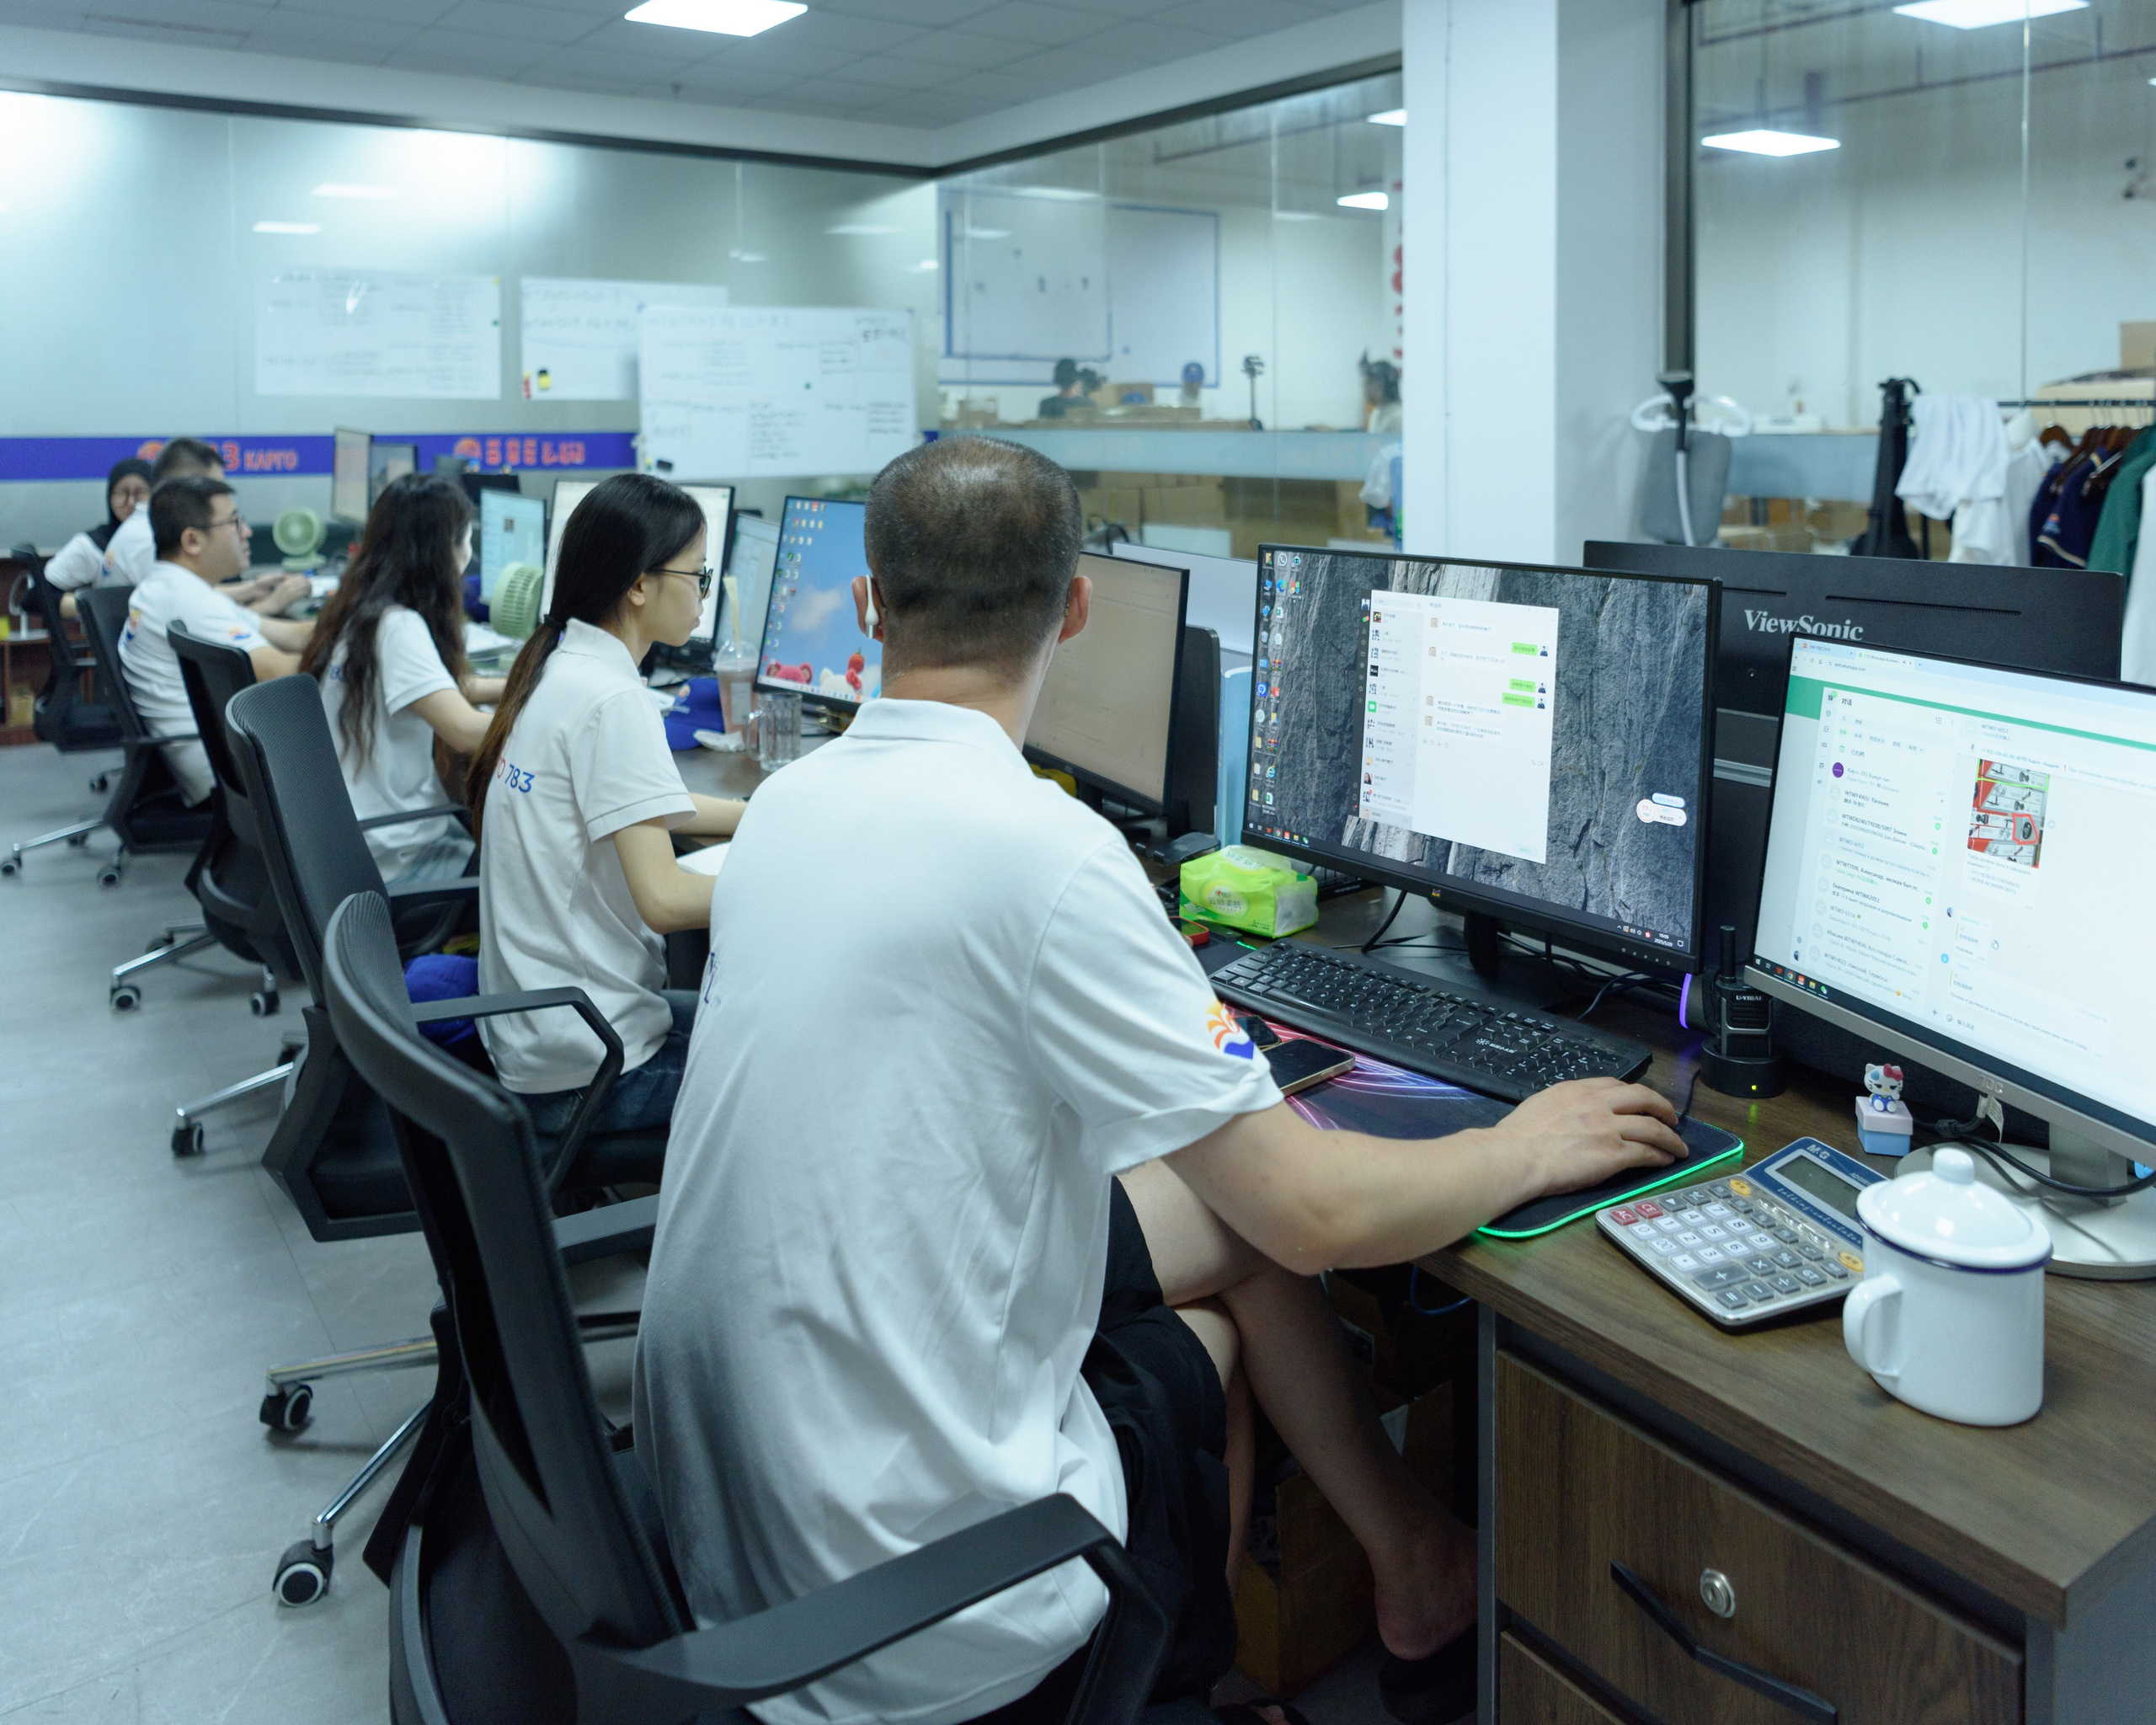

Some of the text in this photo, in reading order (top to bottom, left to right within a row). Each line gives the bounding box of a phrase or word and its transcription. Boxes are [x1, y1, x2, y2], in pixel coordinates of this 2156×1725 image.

[1743, 610, 1864, 641] ViewSonic
[1834, 663, 1866, 672] web.whatsapp.com
[1841, 697, 1852, 707] 对话
[504, 763, 536, 793] 783
[1838, 836, 1865, 849] WTWD-6053
[1833, 882, 1854, 895] Екатерина
[1827, 929, 1843, 939] Максим
[1977, 1076, 2004, 1095] AOC
[1641, 1204, 1656, 1213] CE
[1615, 1210, 1631, 1220] AC
